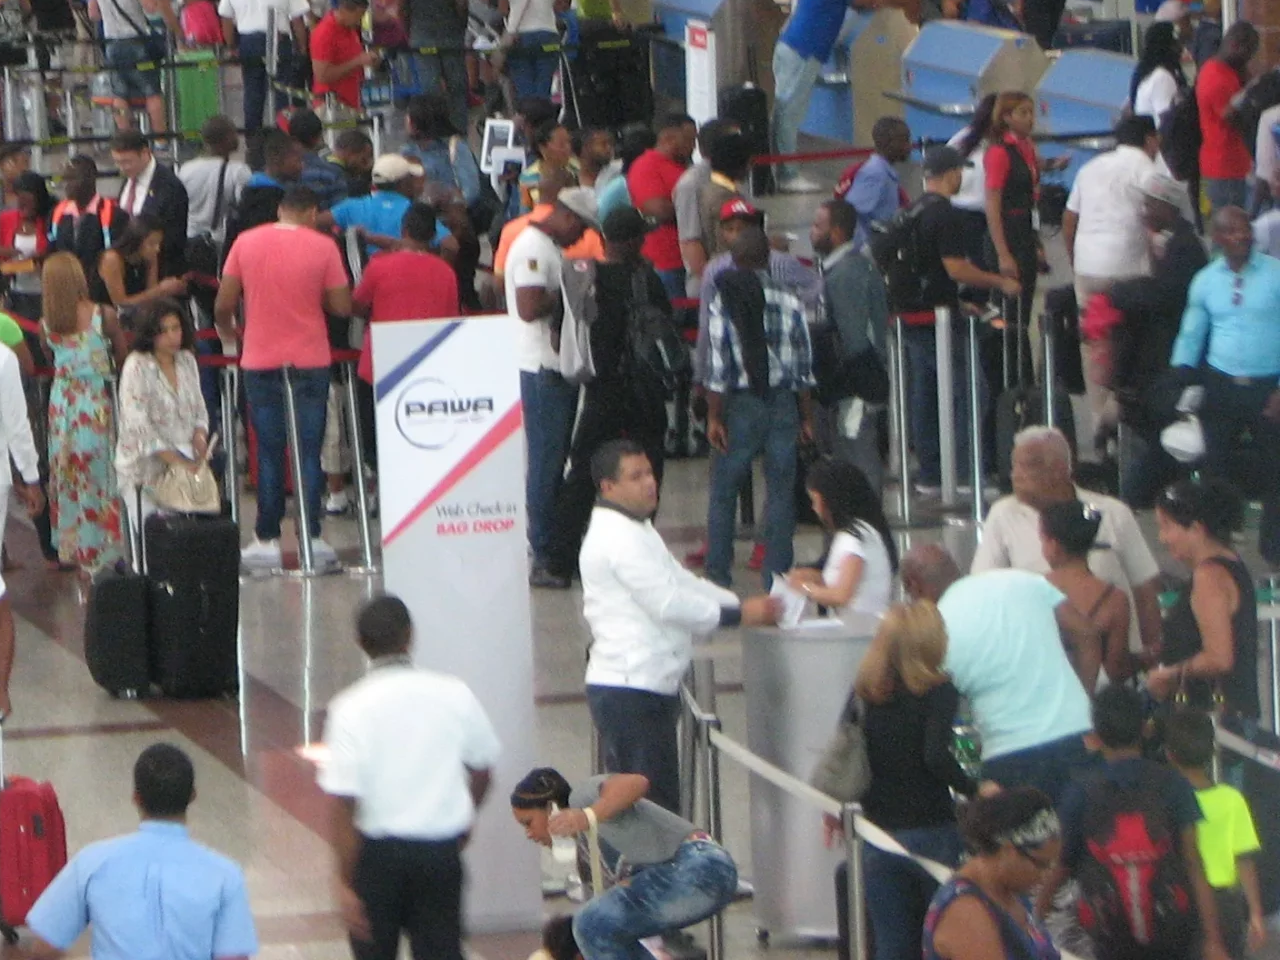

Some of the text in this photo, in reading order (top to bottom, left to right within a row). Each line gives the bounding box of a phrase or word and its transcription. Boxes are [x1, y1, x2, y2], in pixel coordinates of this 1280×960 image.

[405, 397, 494, 417] PAWA
[436, 519, 514, 535] BAG DROP
